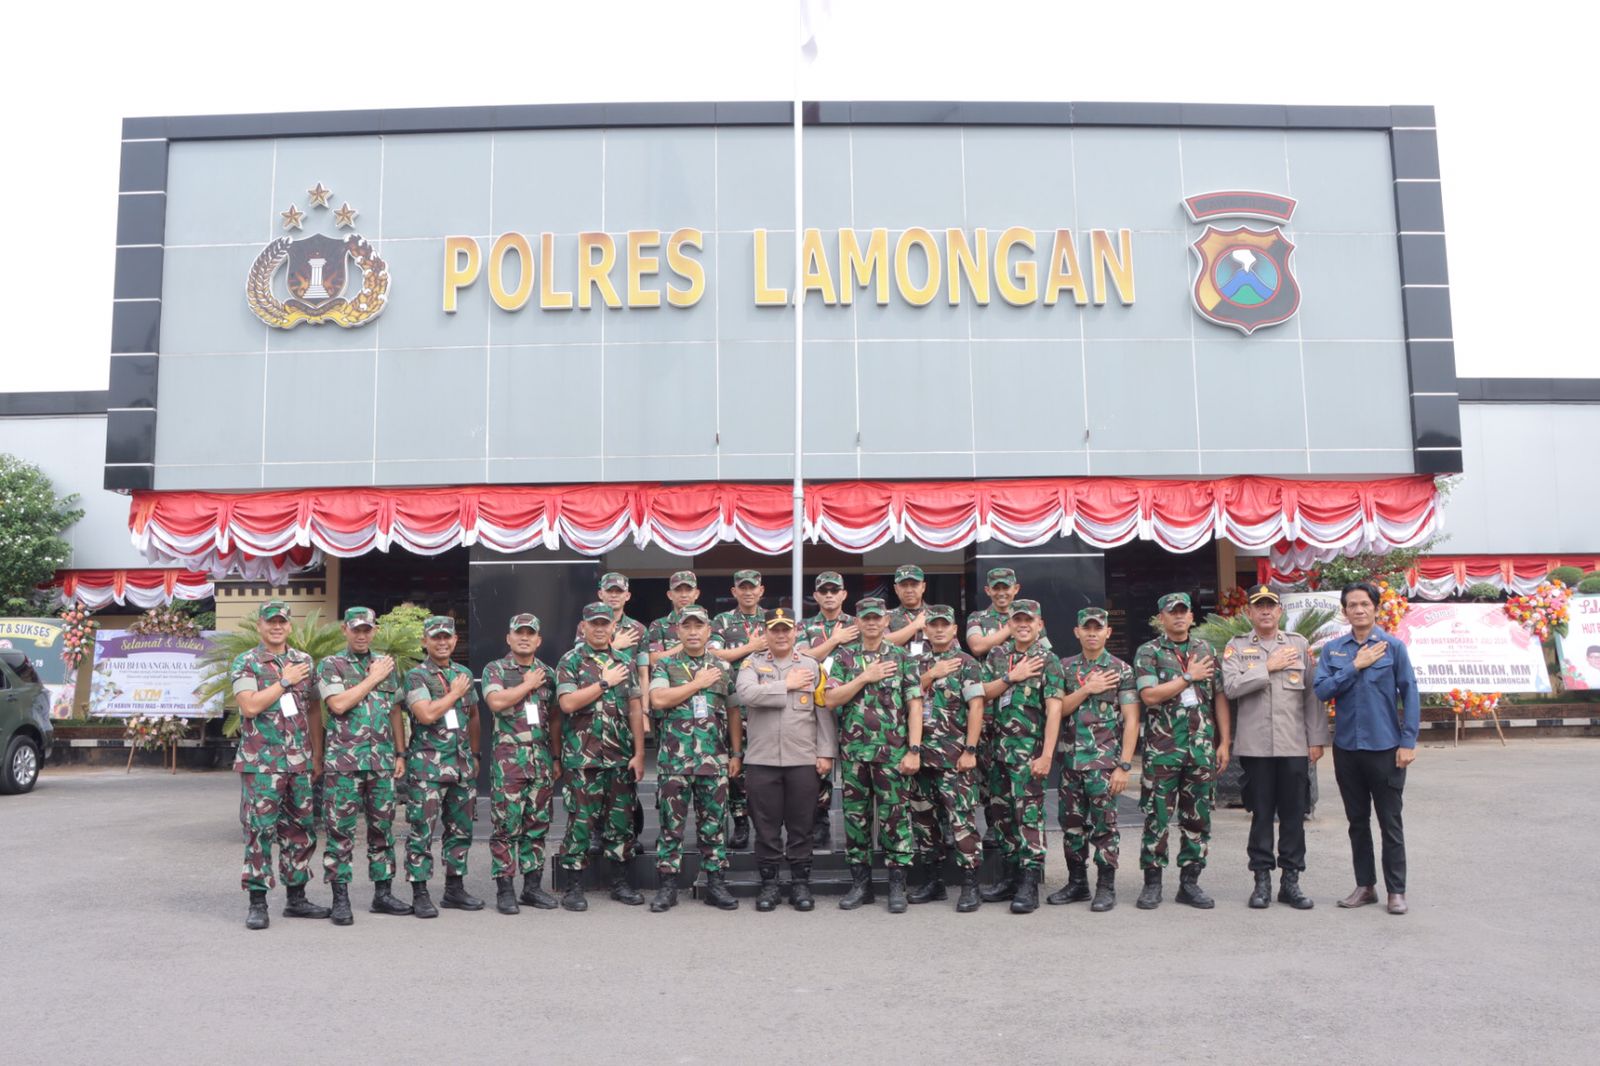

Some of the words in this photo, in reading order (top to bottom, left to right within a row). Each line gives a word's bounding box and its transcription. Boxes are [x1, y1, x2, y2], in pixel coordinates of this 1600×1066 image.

[442, 227, 706, 314] POLRES
[753, 225, 1136, 308] LAMONGAN
[14, 624, 50, 638] SUKSES
[1581, 623, 1596, 635] HUT
[121, 638, 162, 650] Selamat
[105, 662, 126, 670] HARI
[1427, 664, 1457, 675] MOH.
[1511, 664, 1531, 676] MM
[1493, 677, 1531, 685] LAMONGAN
[133, 689, 162, 701] KTM
